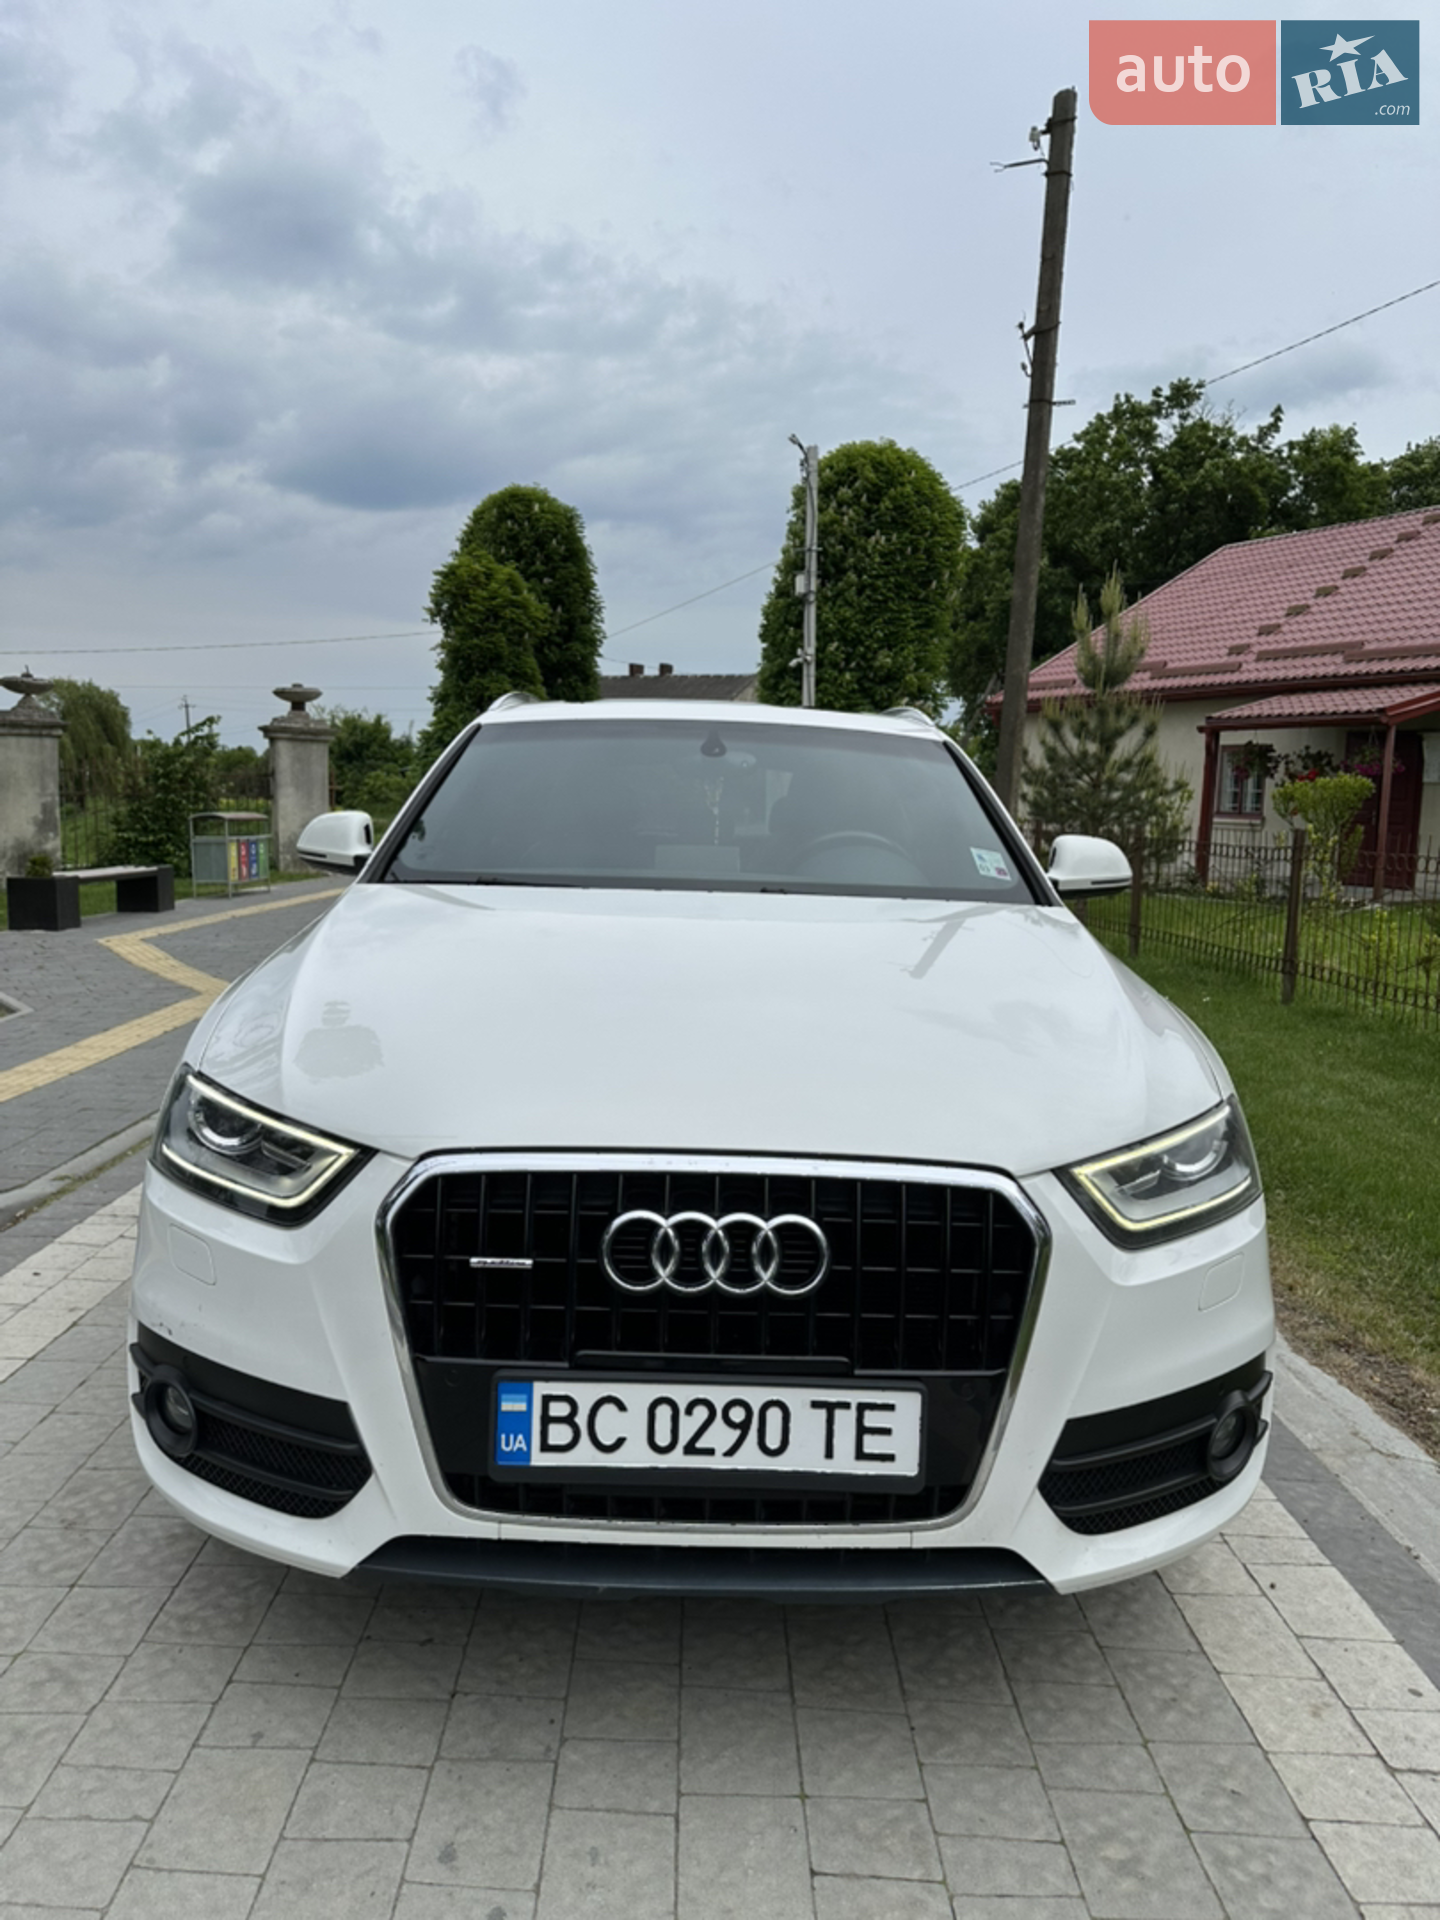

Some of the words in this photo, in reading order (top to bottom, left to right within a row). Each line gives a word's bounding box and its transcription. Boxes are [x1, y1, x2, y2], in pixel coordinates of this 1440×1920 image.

[501, 1434, 527, 1452] UA
[539, 1393, 629, 1454] BC
[646, 1396, 791, 1457] 0290
[810, 1399, 896, 1463] TE
